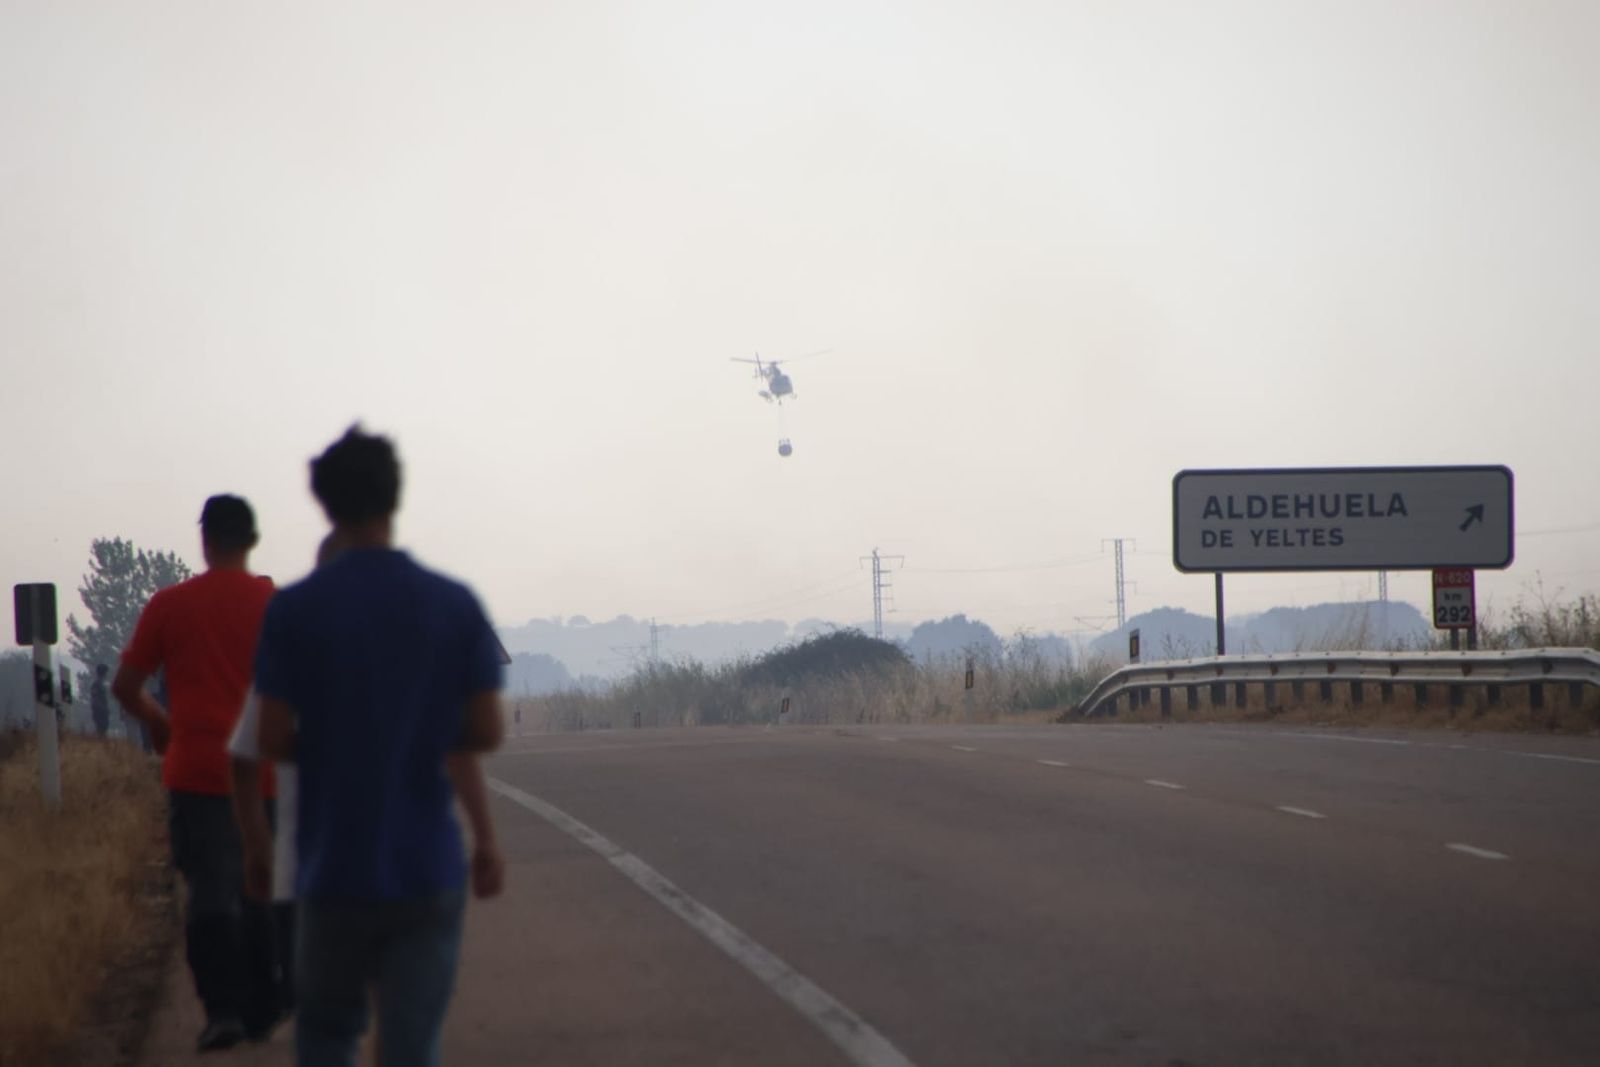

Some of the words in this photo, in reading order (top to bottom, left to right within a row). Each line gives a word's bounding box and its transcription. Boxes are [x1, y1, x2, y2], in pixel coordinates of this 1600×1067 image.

[1202, 493, 1408, 519] ALDEHUELA
[1202, 529, 1233, 547] DE
[1250, 528, 1344, 547] YELTES
[1444, 592, 1462, 601] km
[1438, 605, 1471, 623] 292
